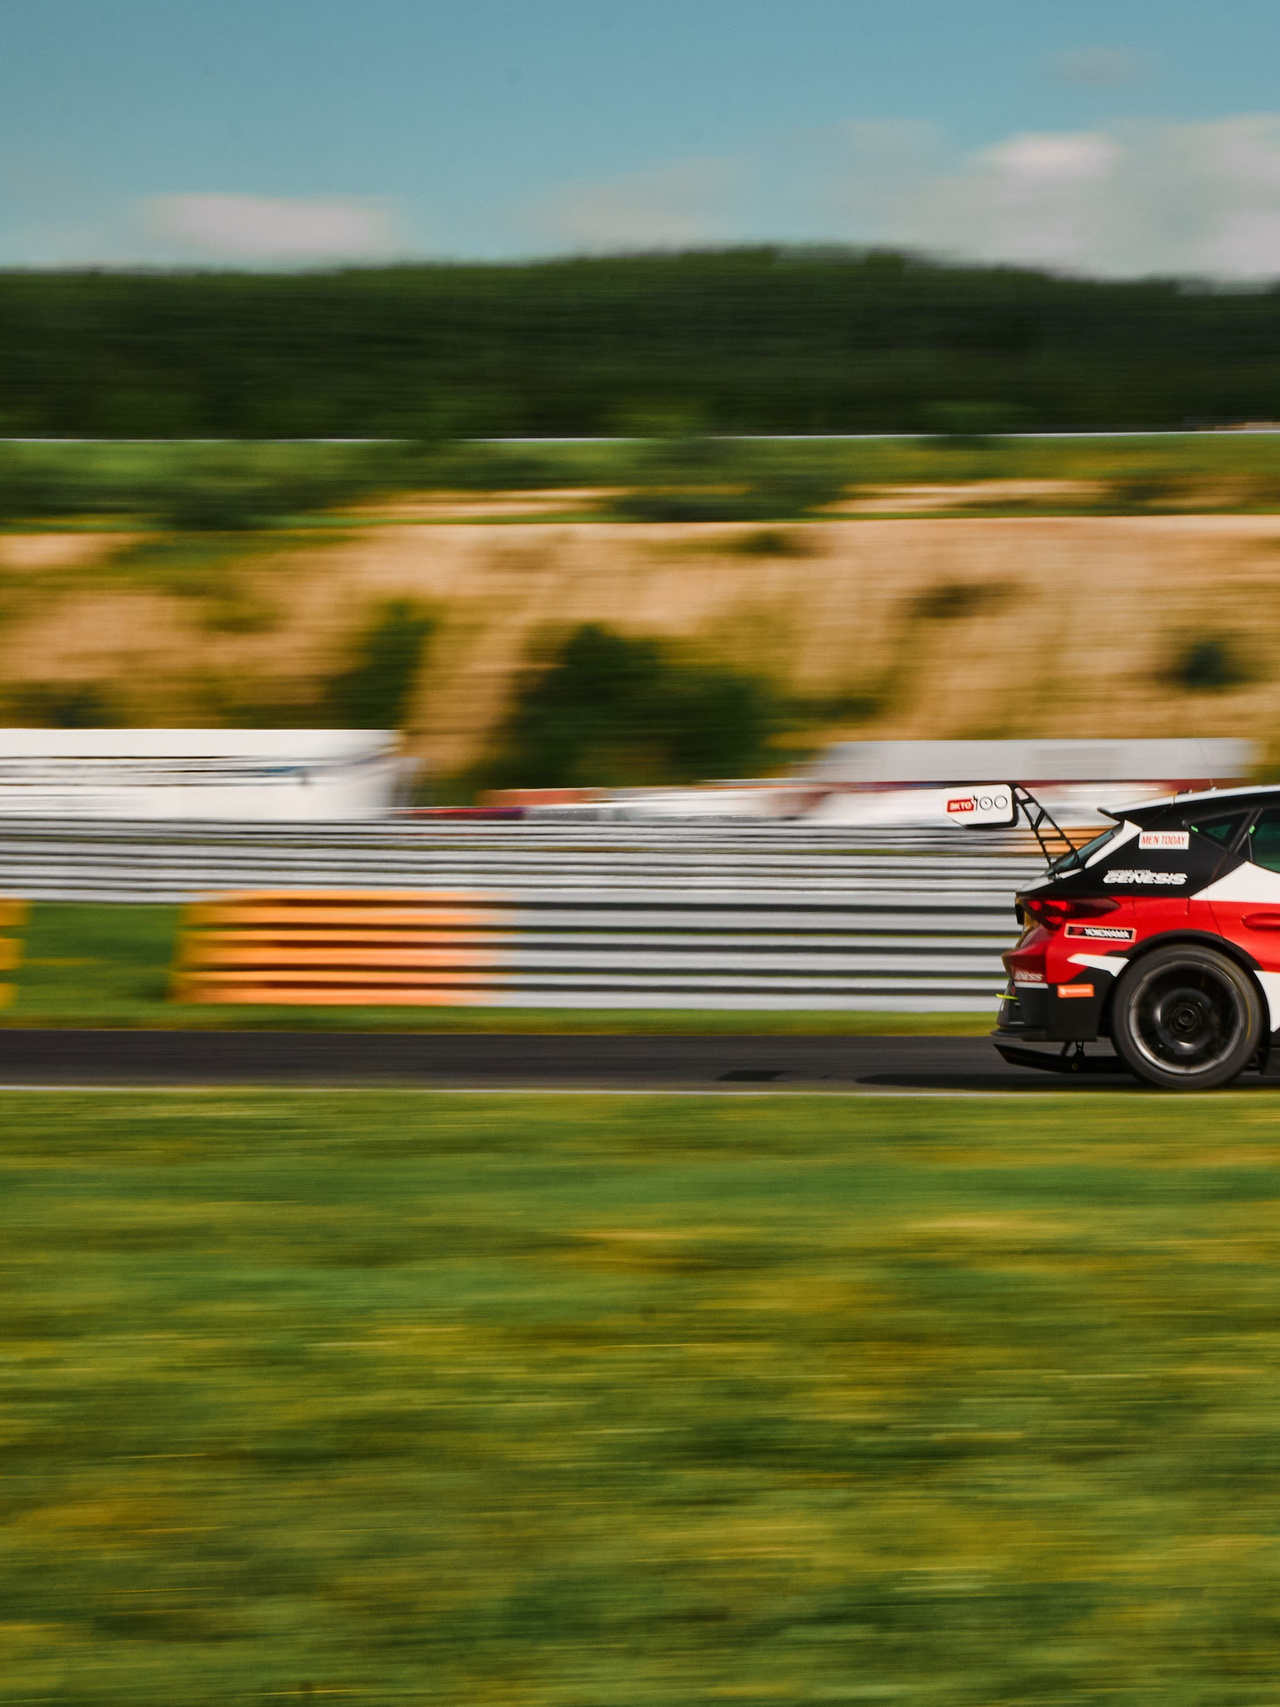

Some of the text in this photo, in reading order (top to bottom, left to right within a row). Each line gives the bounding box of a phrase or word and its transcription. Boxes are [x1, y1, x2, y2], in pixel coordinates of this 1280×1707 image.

[1142, 835, 1187, 846] MEN TODAY
[1102, 872, 1188, 885] GENESIS
[1084, 927, 1131, 939] YOKOHAMA
